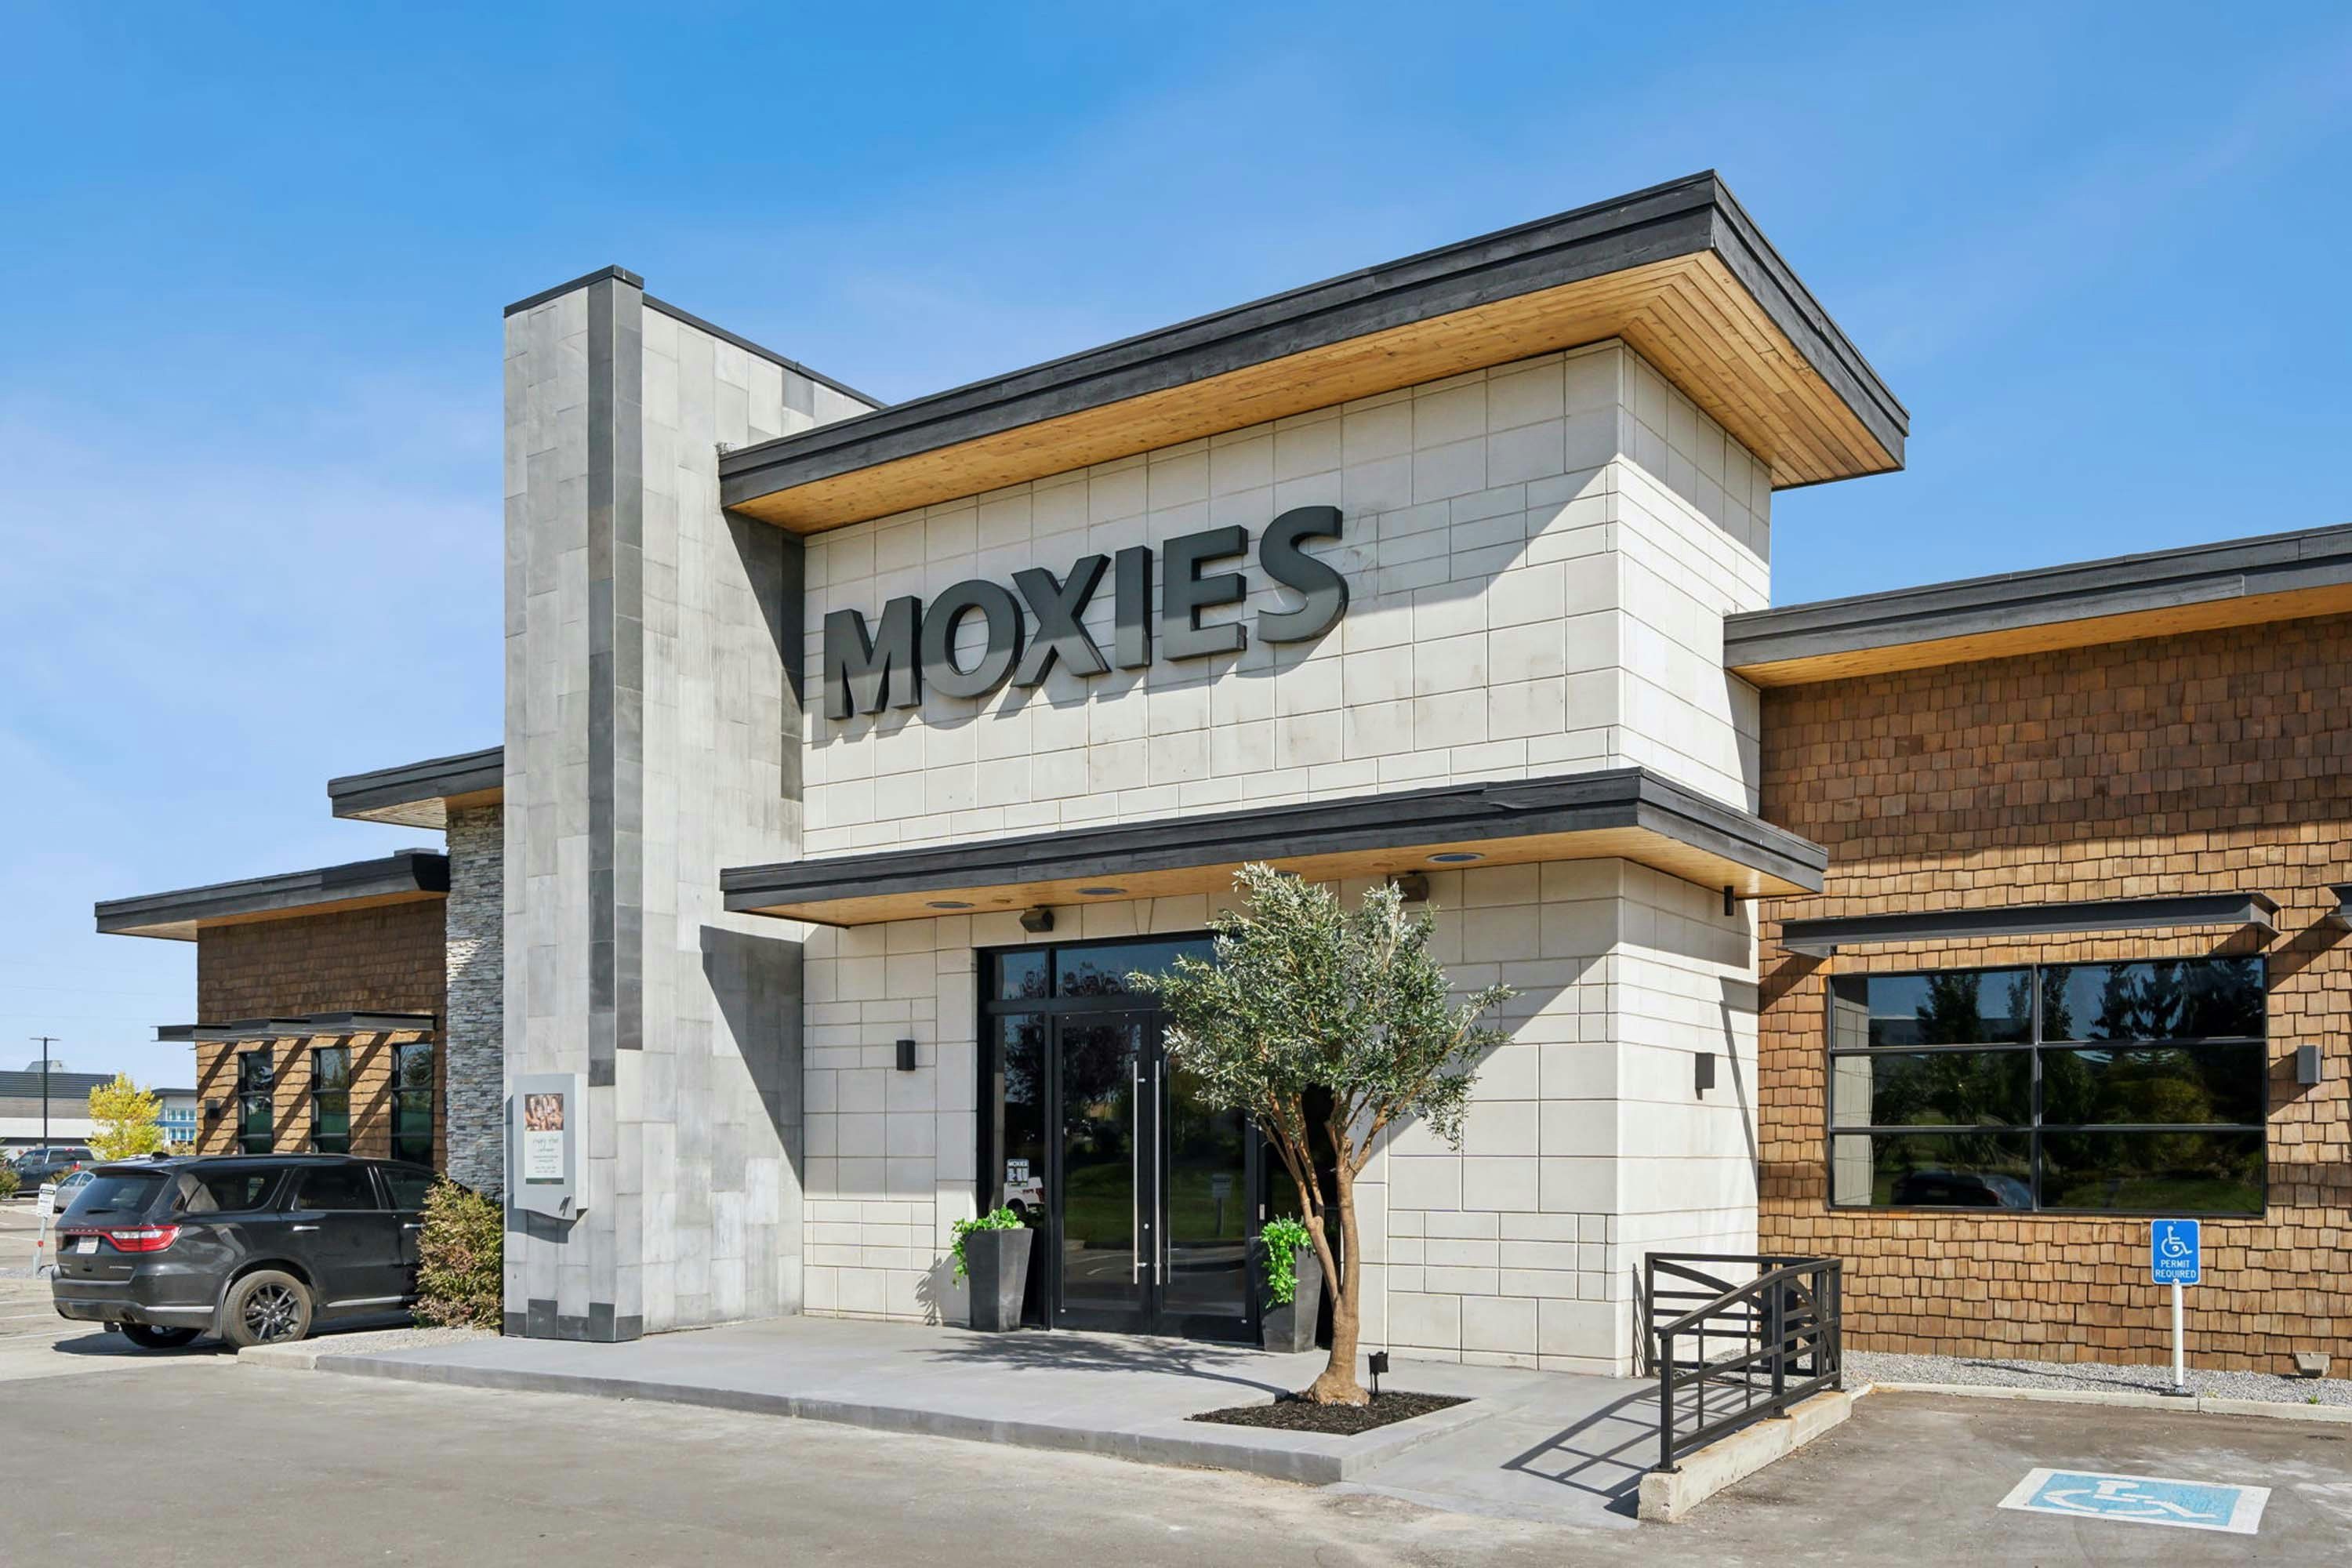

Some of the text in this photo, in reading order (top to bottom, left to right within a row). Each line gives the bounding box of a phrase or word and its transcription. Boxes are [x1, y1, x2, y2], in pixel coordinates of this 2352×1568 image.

[823, 505, 1350, 720] MOXIES
[2161, 1259, 2190, 1269] PERMIT
[2154, 1269, 2197, 1279] REQUIRED
